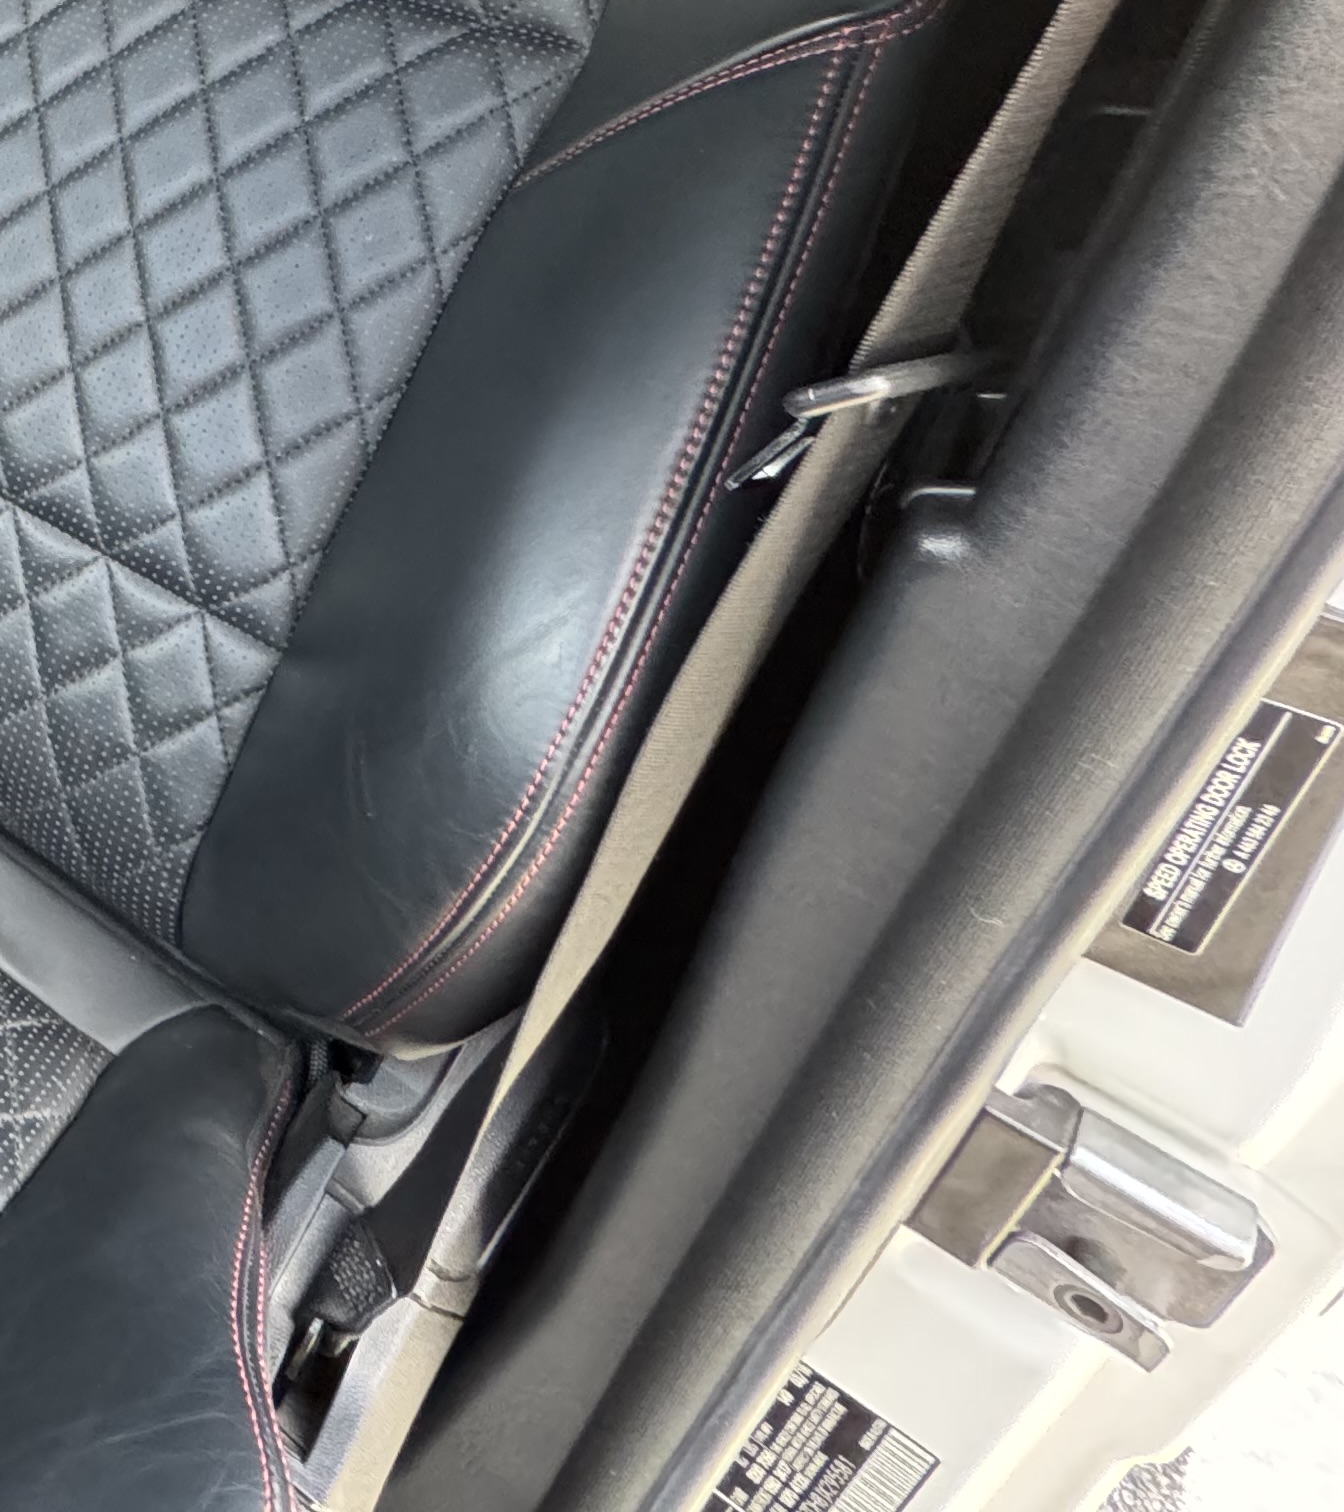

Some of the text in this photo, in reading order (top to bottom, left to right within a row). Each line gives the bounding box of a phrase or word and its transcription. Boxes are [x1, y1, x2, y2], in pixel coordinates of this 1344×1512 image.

[1143, 737, 1262, 901] SPEED OPERATING DOOR LOCK
